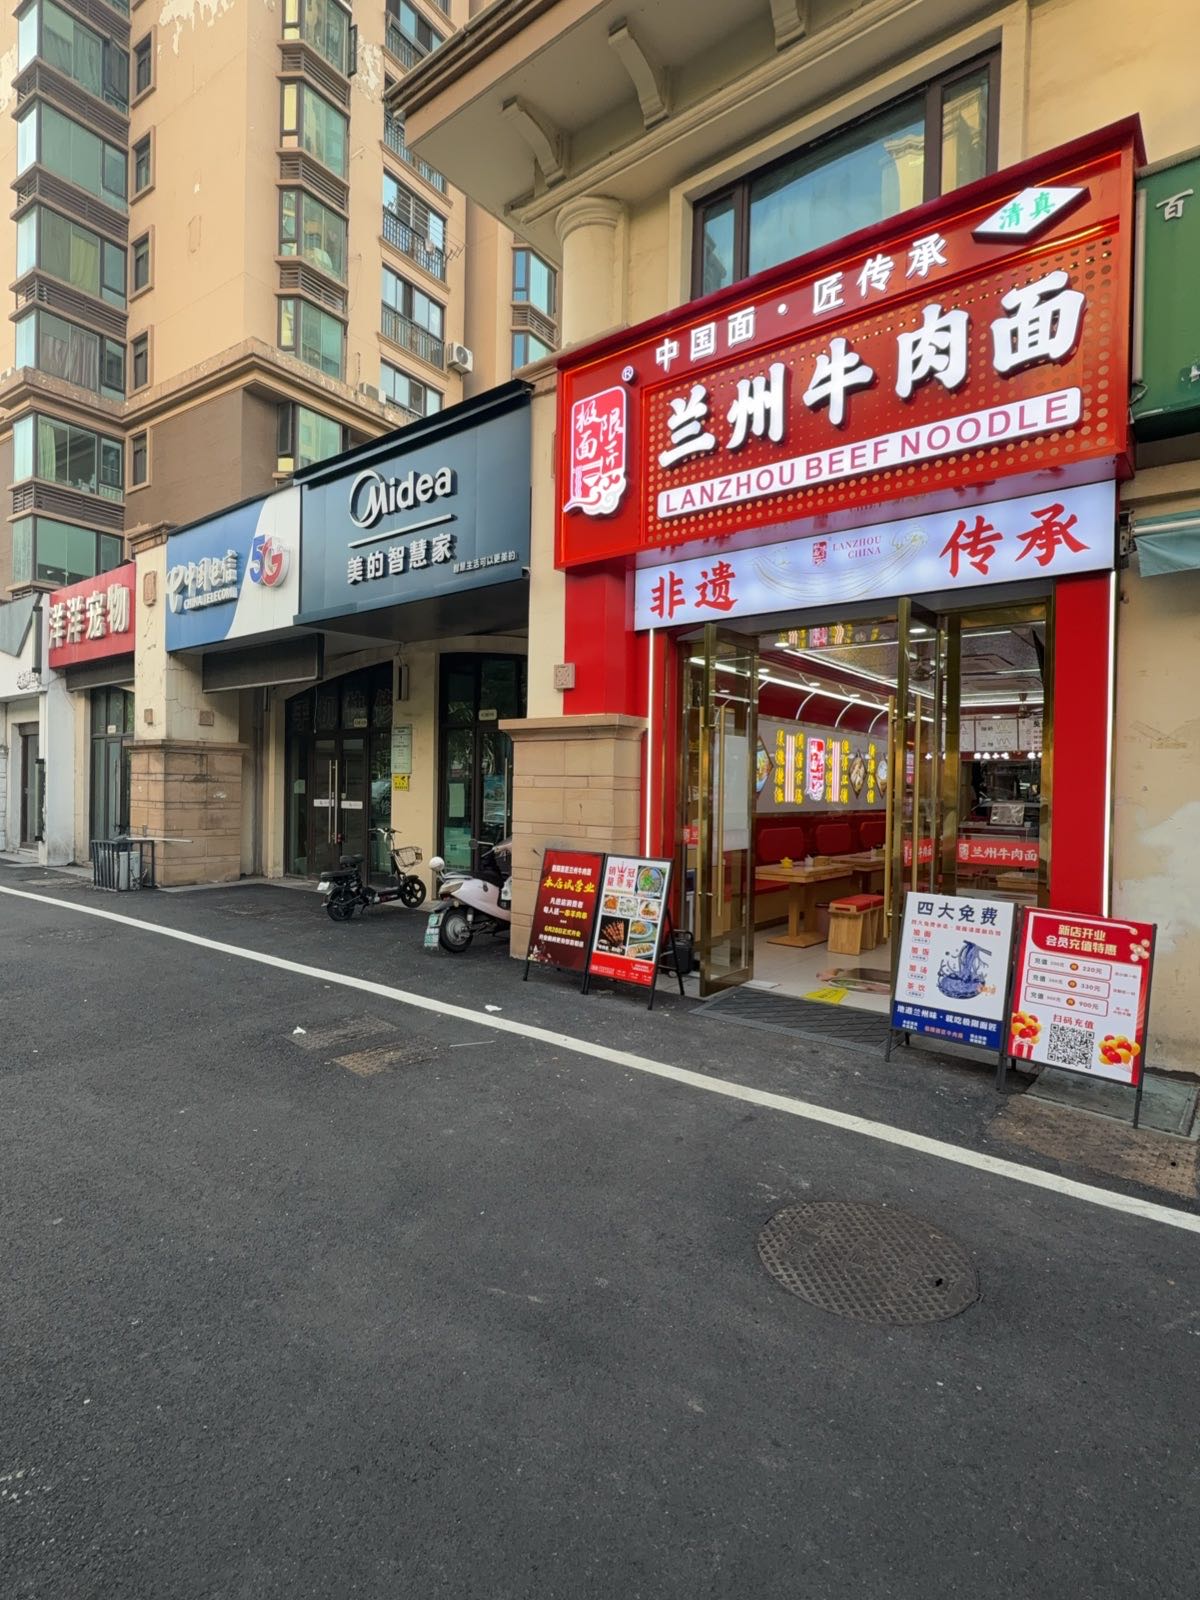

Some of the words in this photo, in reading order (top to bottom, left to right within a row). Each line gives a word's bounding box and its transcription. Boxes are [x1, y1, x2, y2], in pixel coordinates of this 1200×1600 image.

[999, 191, 1056, 230] 清真
[1155, 188, 1194, 221] 百
[658, 270, 1086, 468] 兰州牛肉面
[665, 462, 796, 513] LANZHOU
[805, 438, 890, 480] BEEF
[901, 394, 1069, 458] NOODLE
[349, 466, 452, 528] Midea
[833, 536, 881, 551] LANZHOU
[847, 547, 881, 559] CHINA
[249, 534, 285, 587] 5G
[347, 533, 453, 584] 美的智慧家
[650, 560, 738, 619] 非遗
[939, 502, 1091, 579] 传承
[48, 583, 130, 649] 洋洋宠物
[970, 845, 1038, 862] 兰州牛肉面
[544, 876, 596, 893] 本店试营业
[917, 901, 998, 926] 四大免费
[1046, 935, 1117, 956] 会员充值特惠
[1058, 924, 1106, 942] 新店开业
[1082, 966, 1103, 975] 220元
[1079, 1001, 1099, 1010] 900元
[1052, 1013, 1095, 1029] 扫码充值
